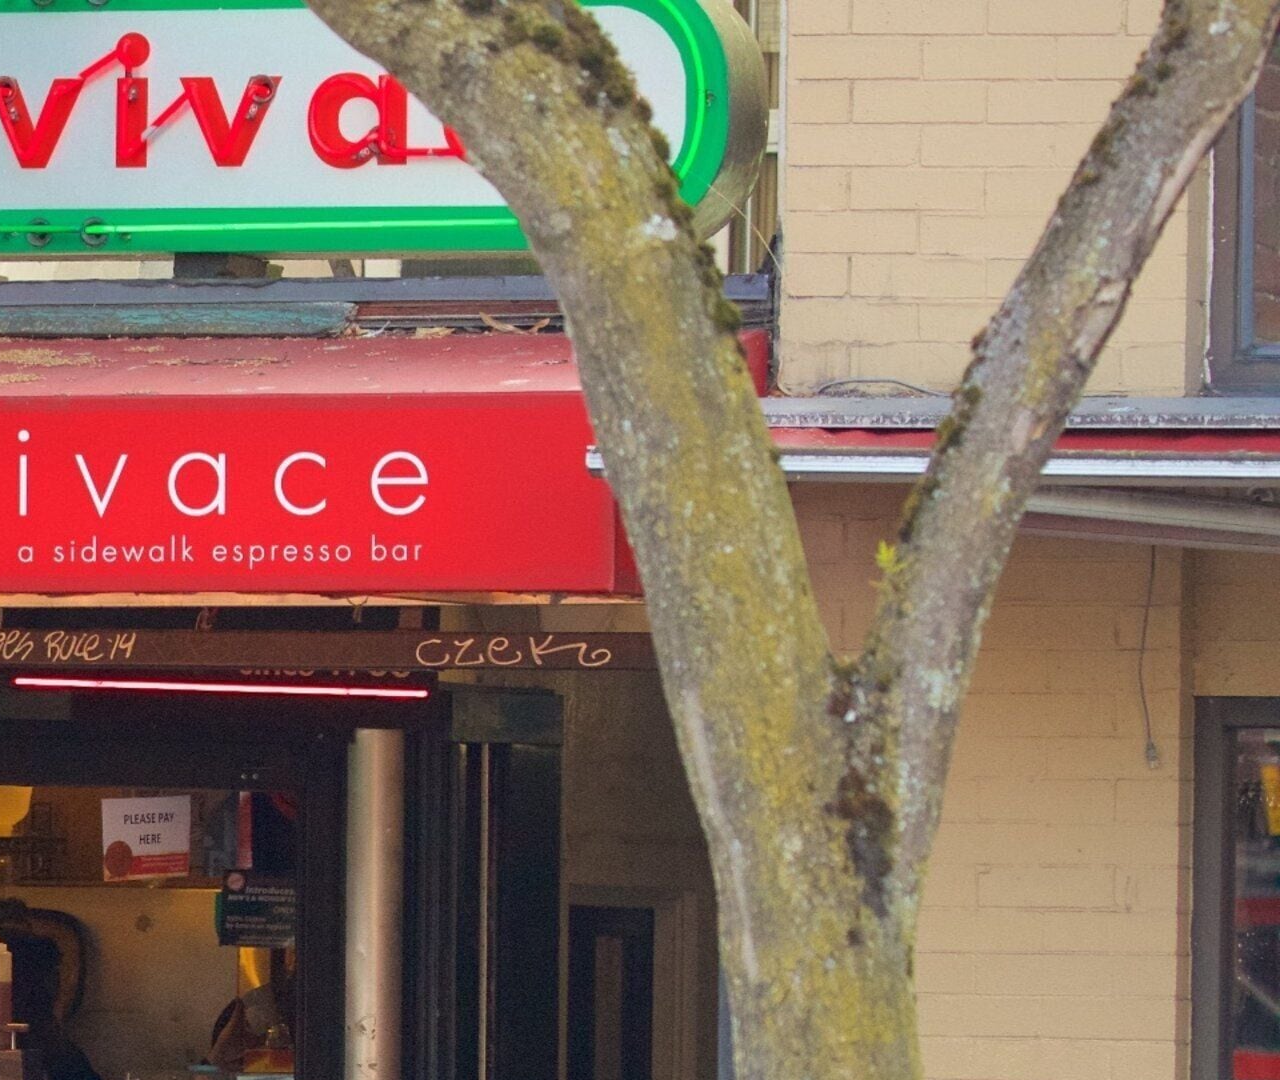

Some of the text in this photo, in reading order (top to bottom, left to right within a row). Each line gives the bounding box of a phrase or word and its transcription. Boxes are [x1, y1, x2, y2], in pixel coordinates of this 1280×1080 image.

[17, 534, 424, 570] a sidewalk espresso bar
[123, 812, 175, 825] PLEASE PAY
[139, 833, 162, 845] HERE
